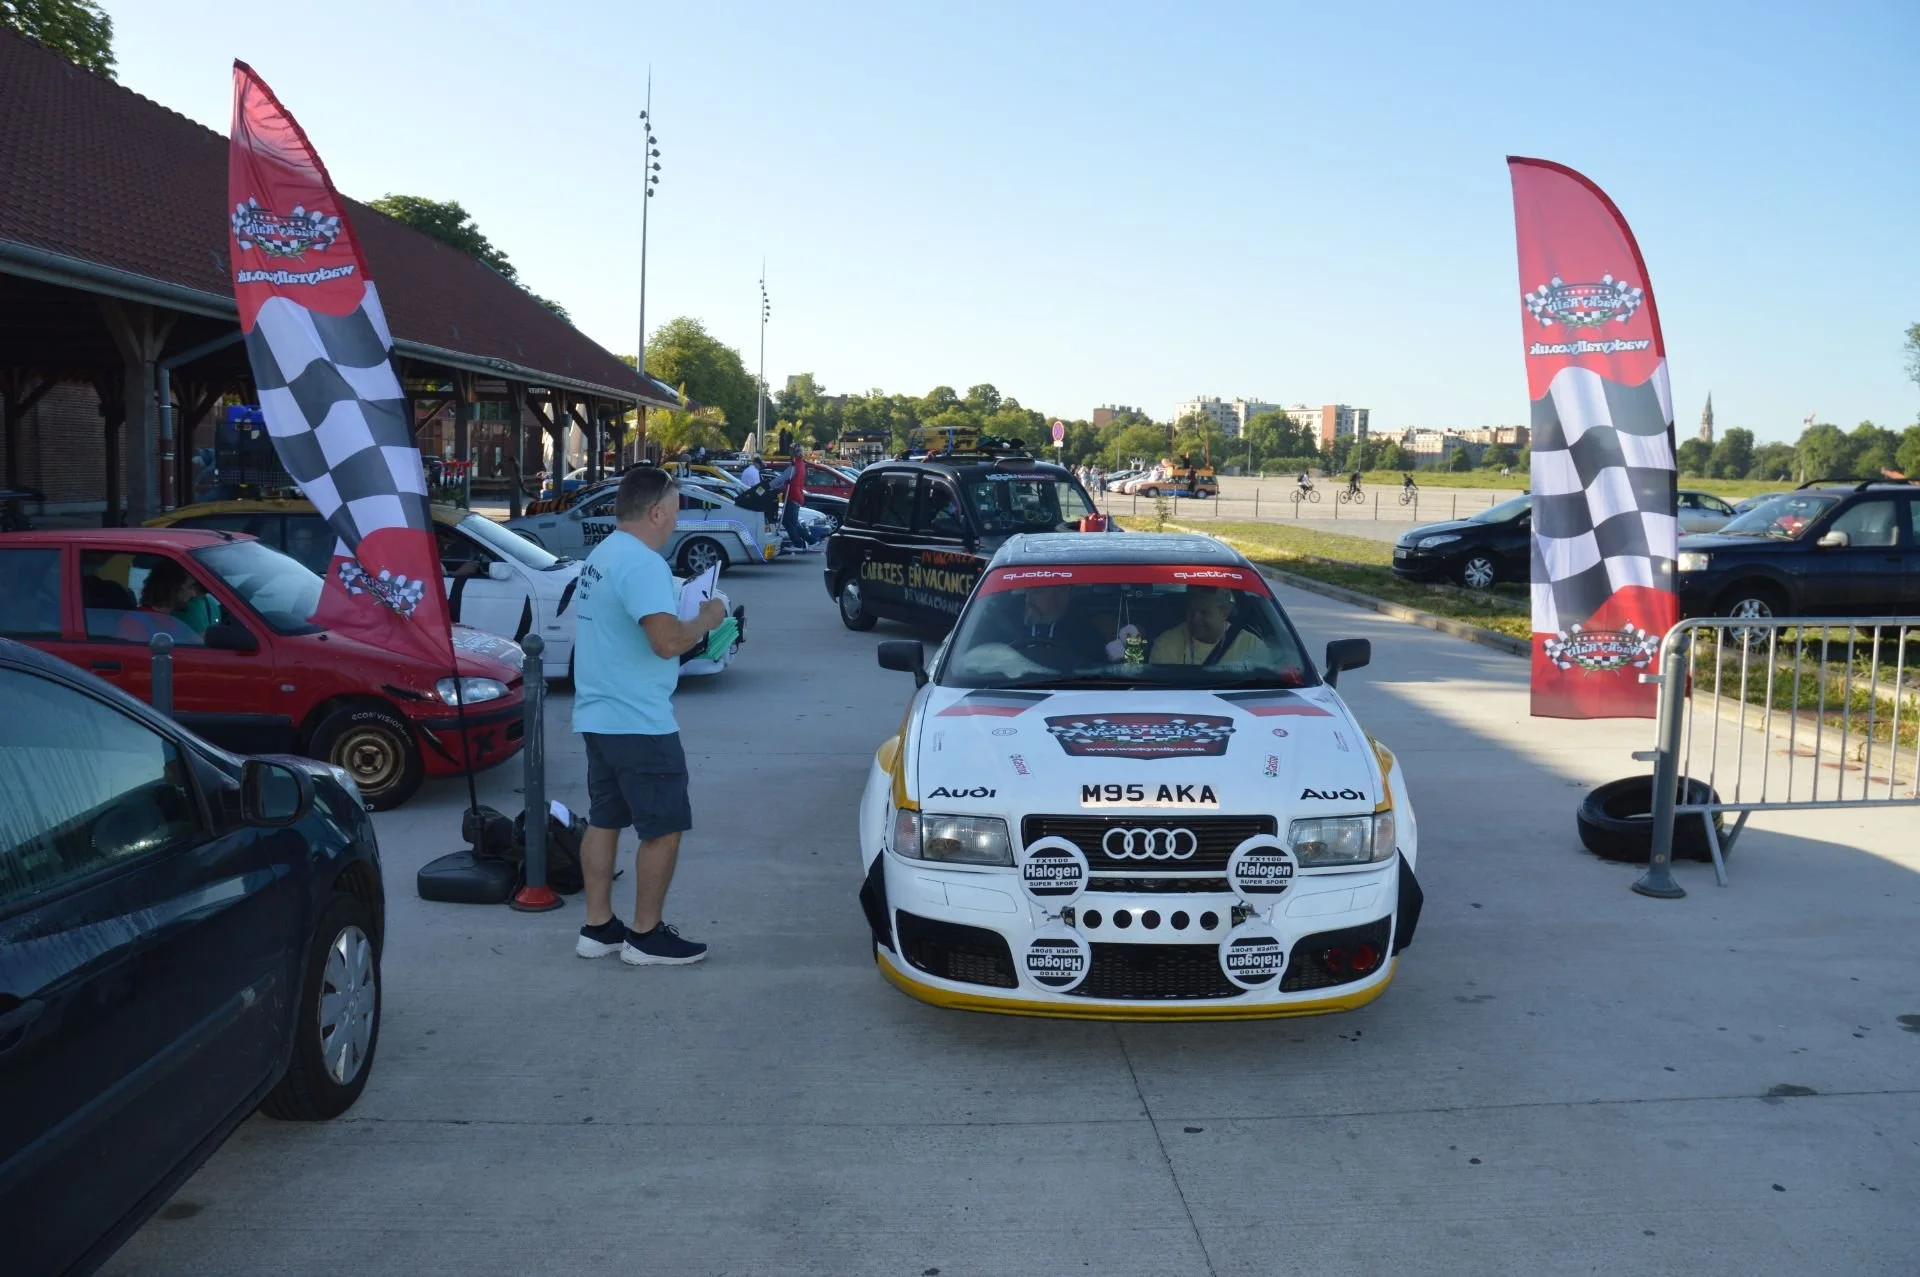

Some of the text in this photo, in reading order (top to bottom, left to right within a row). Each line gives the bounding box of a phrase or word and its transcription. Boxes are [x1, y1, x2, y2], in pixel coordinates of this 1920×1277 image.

[1003, 571, 1072, 580] quattro
[1174, 571, 1243, 580] quattro
[927, 786, 997, 799] Audi
[1082, 784, 1217, 804] M95 AKA
[1300, 788, 1366, 801] Audi
[1025, 864, 1080, 879] Halogen
[1238, 862, 1291, 878] Halogen
[1029, 956, 1082, 971] Halogen
[1229, 954, 1282, 968] Halogen
